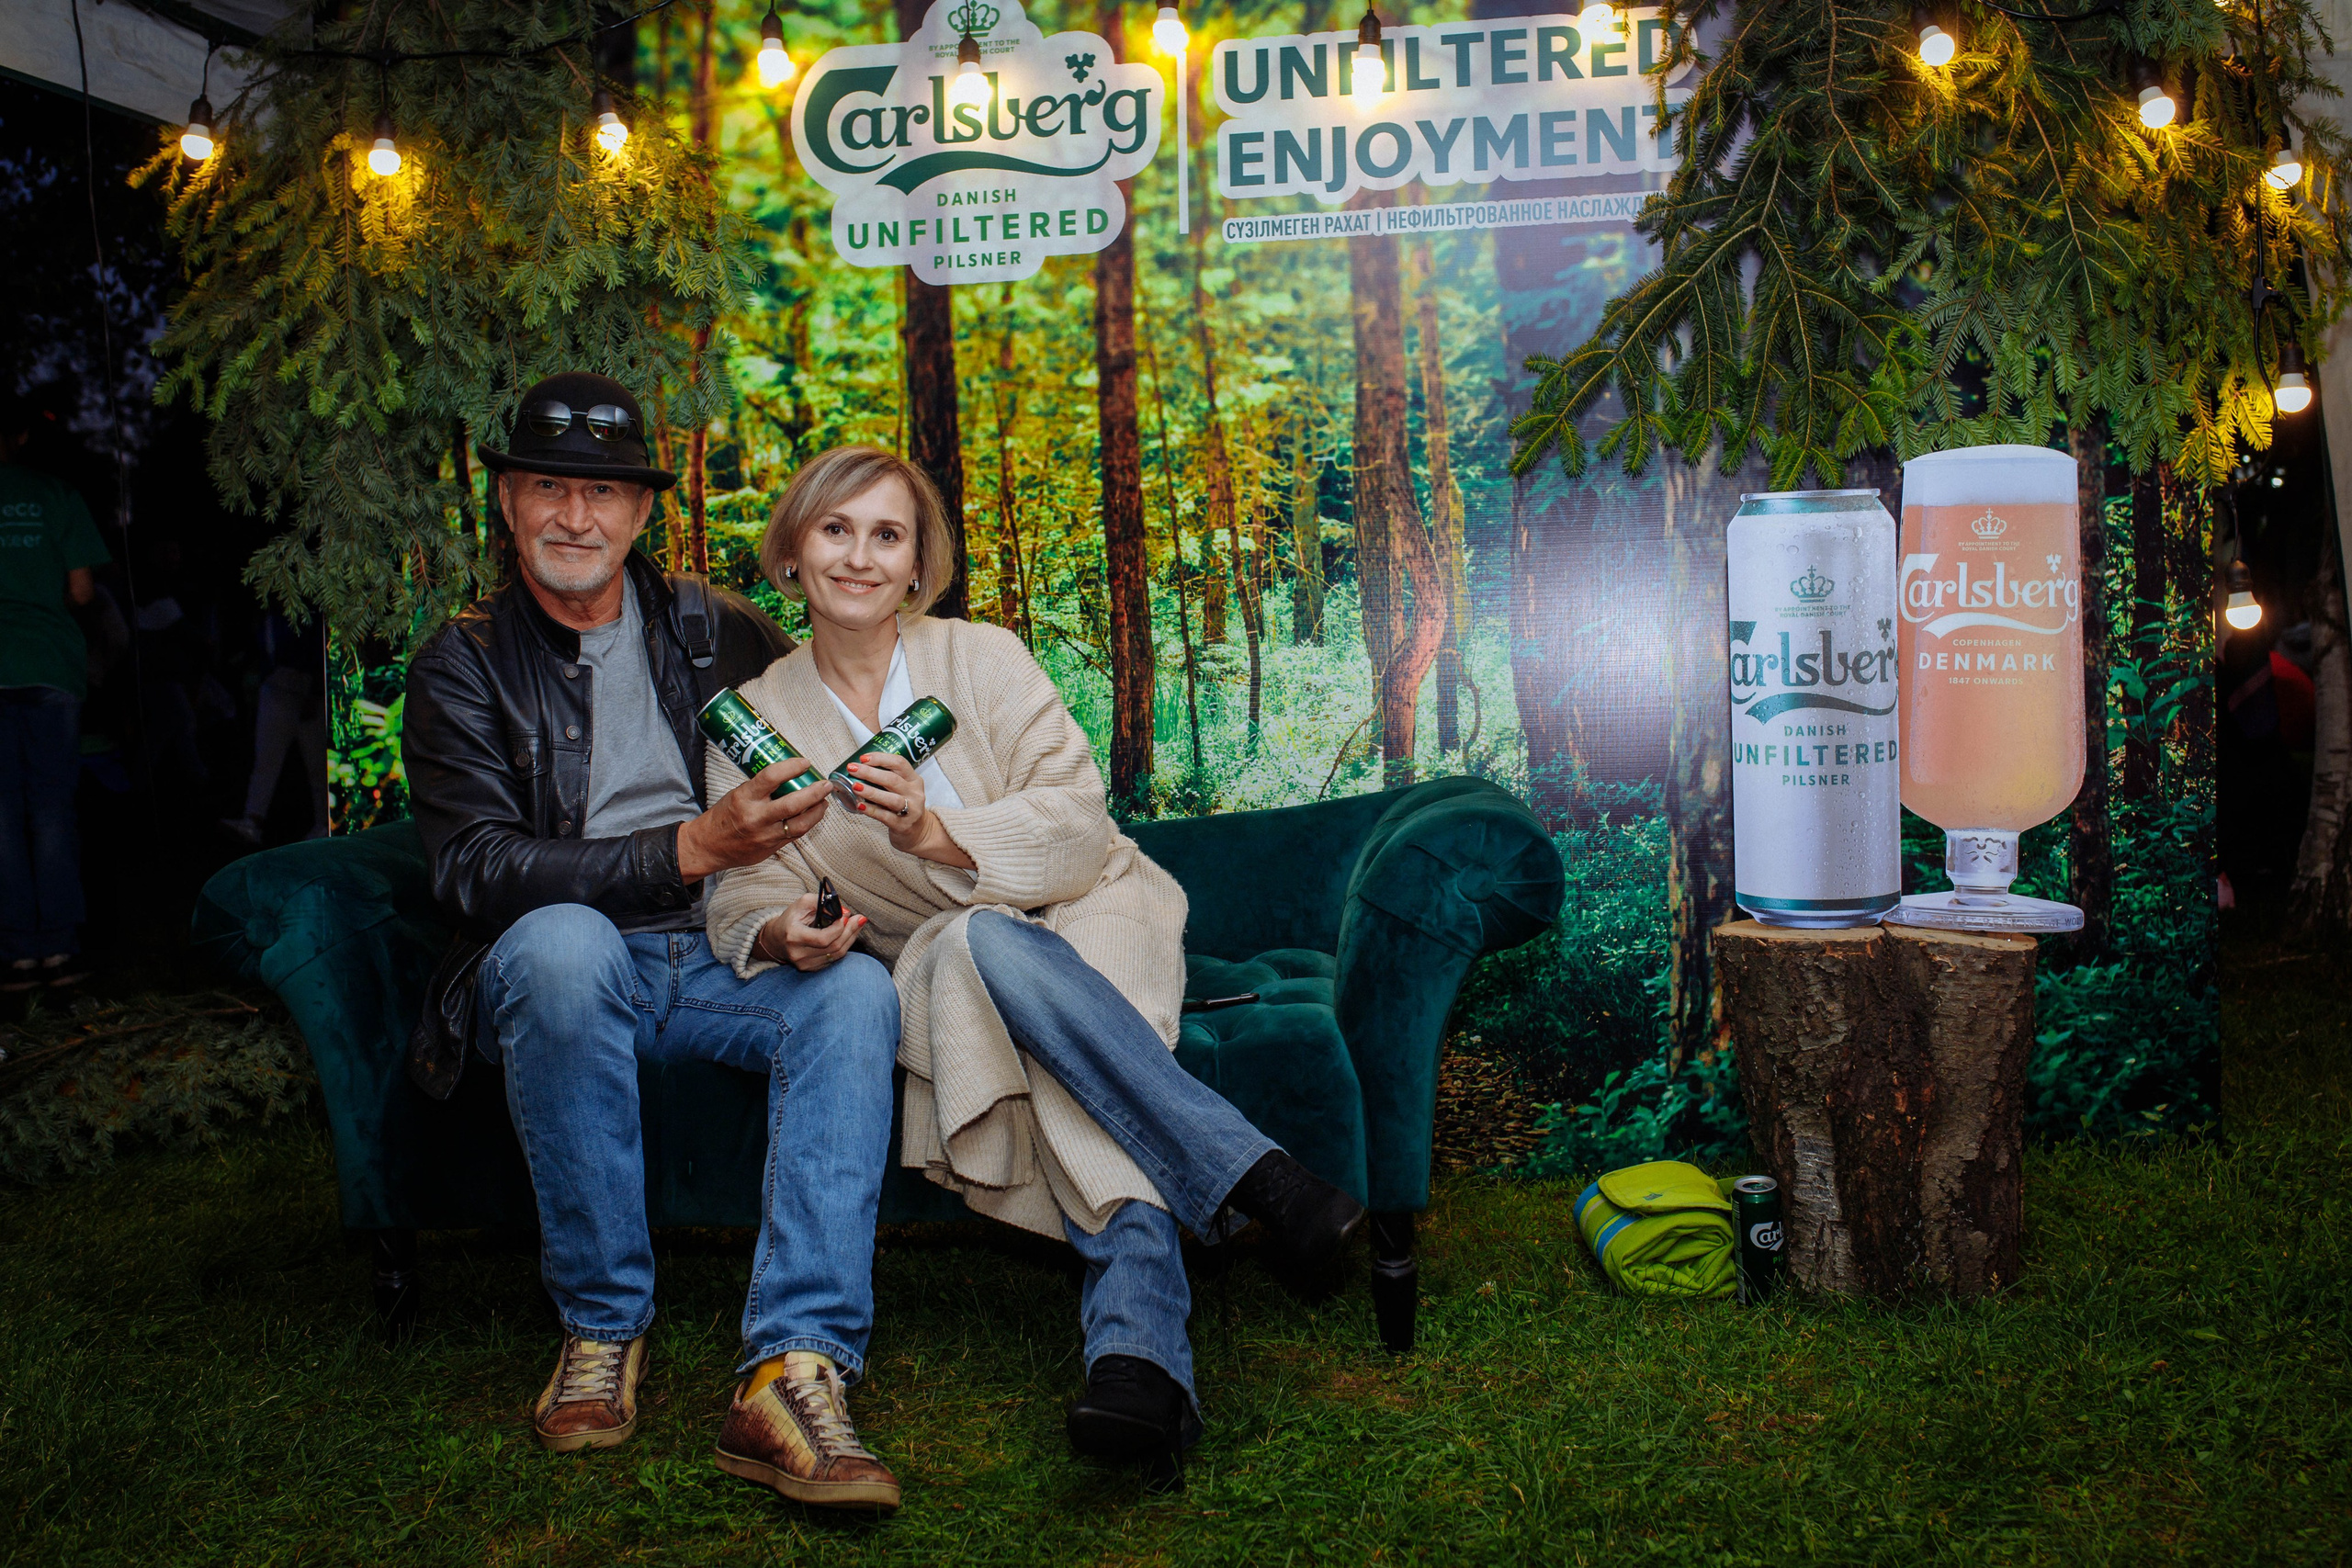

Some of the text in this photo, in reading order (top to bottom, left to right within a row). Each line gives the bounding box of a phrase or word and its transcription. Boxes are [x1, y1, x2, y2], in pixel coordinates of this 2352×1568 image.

[939, 39, 993, 51] APPOENT
[989, 46, 1015, 54] COURT
[804, 65, 1152, 175] Carlsberg
[1228, 103, 1685, 193] ENJOYMENT
[937, 188, 1017, 208] DANISH
[1324, 213, 1372, 233] РАХАТ
[1386, 201, 1553, 230] НЕФИЛЬТРОВАННОЕ
[1557, 196, 1643, 220] НАСЛАЖД
[848, 208, 1109, 250] UNFILTERED
[933, 250, 1022, 270] PILSNER
[1899, 553, 2078, 623] Carlsberg
[1952, 638, 2021, 647] COPENHAGEN
[1918, 652, 2055, 671] DENMARK
[1973, 677, 2024, 685] ONWARDS
[1783, 725, 1847, 737] DANISH
[1734, 739, 1897, 766] UNFILTERED
[1782, 773, 1850, 786] PILSNER
